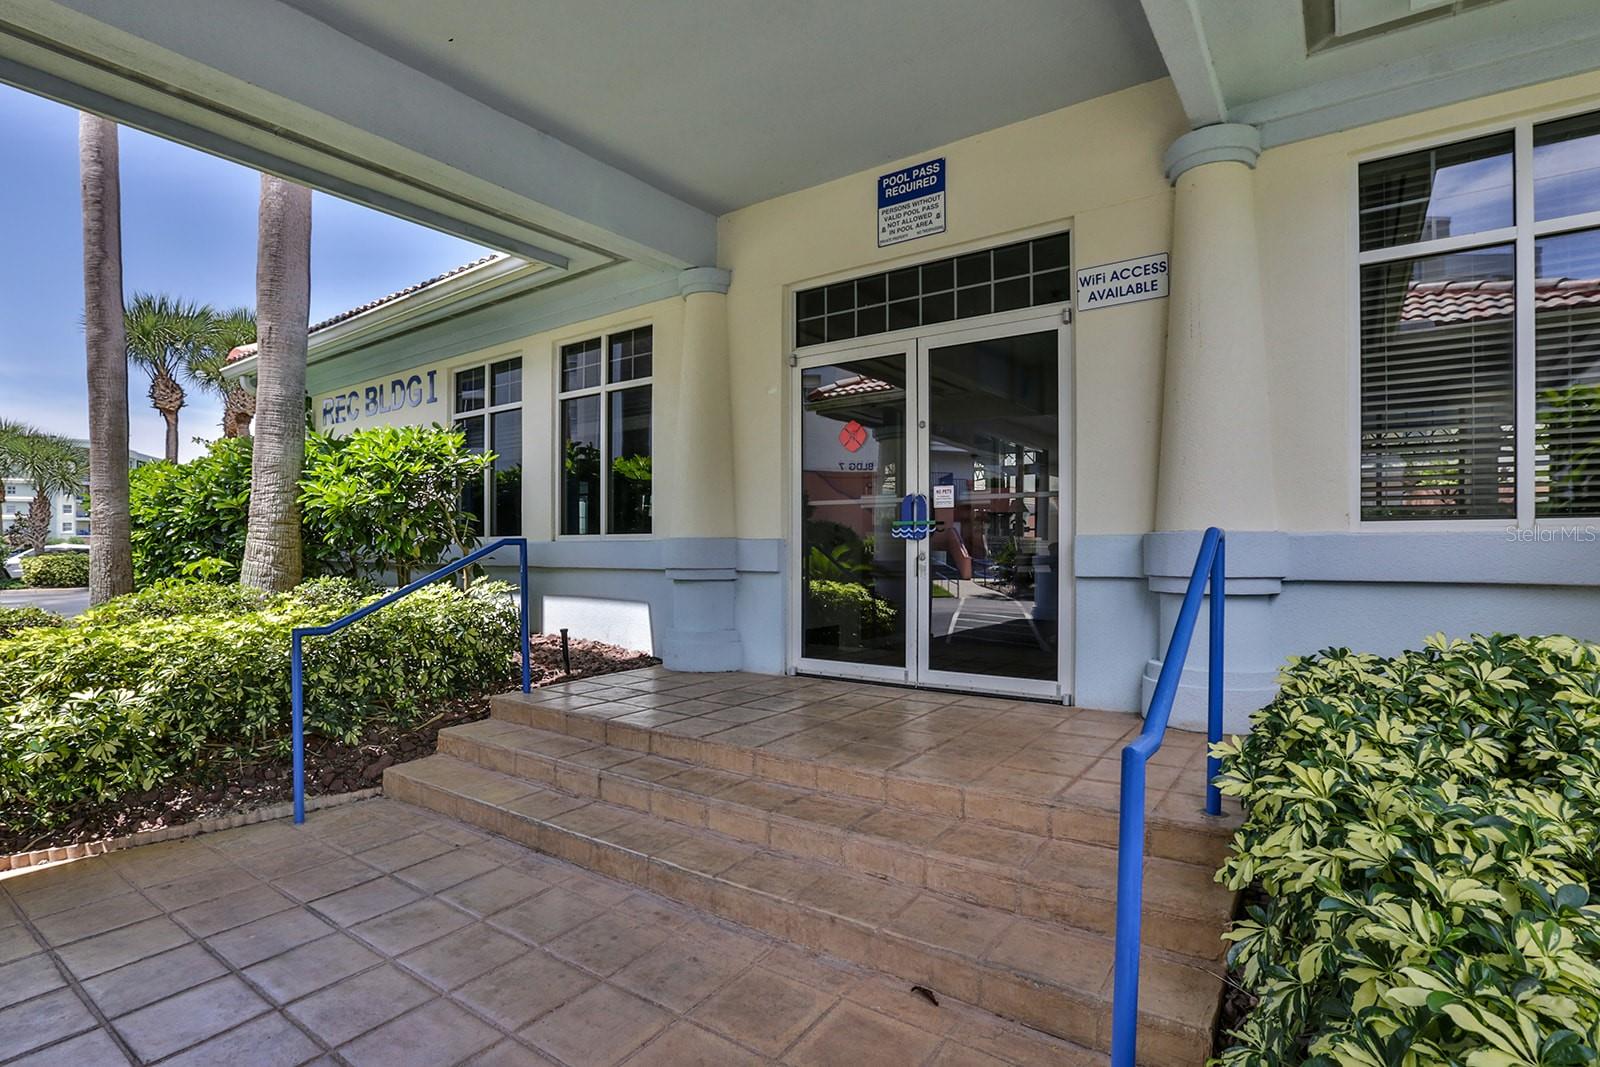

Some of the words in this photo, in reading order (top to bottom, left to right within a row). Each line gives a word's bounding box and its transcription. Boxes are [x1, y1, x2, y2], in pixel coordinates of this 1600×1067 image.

[882, 172, 910, 188] POOL
[912, 163, 940, 179] PASS
[885, 175, 937, 198] REQUIRED
[881, 202, 911, 215] PERSONS
[912, 194, 941, 207] WITHOUT
[883, 212, 902, 222] VALID
[903, 208, 920, 217] POOL
[922, 202, 939, 212] PASS
[887, 221, 900, 229] NOT
[901, 212, 933, 225] ALLOWED
[897, 225, 913, 233] POOL
[915, 219, 933, 229] AREA
[1078, 272, 1106, 287] WiFi
[1109, 261, 1167, 282] ACCESS
[1087, 279, 1158, 303] AVAILABLE
[322, 390, 359, 426] REC
[365, 374, 423, 417] BLDG
